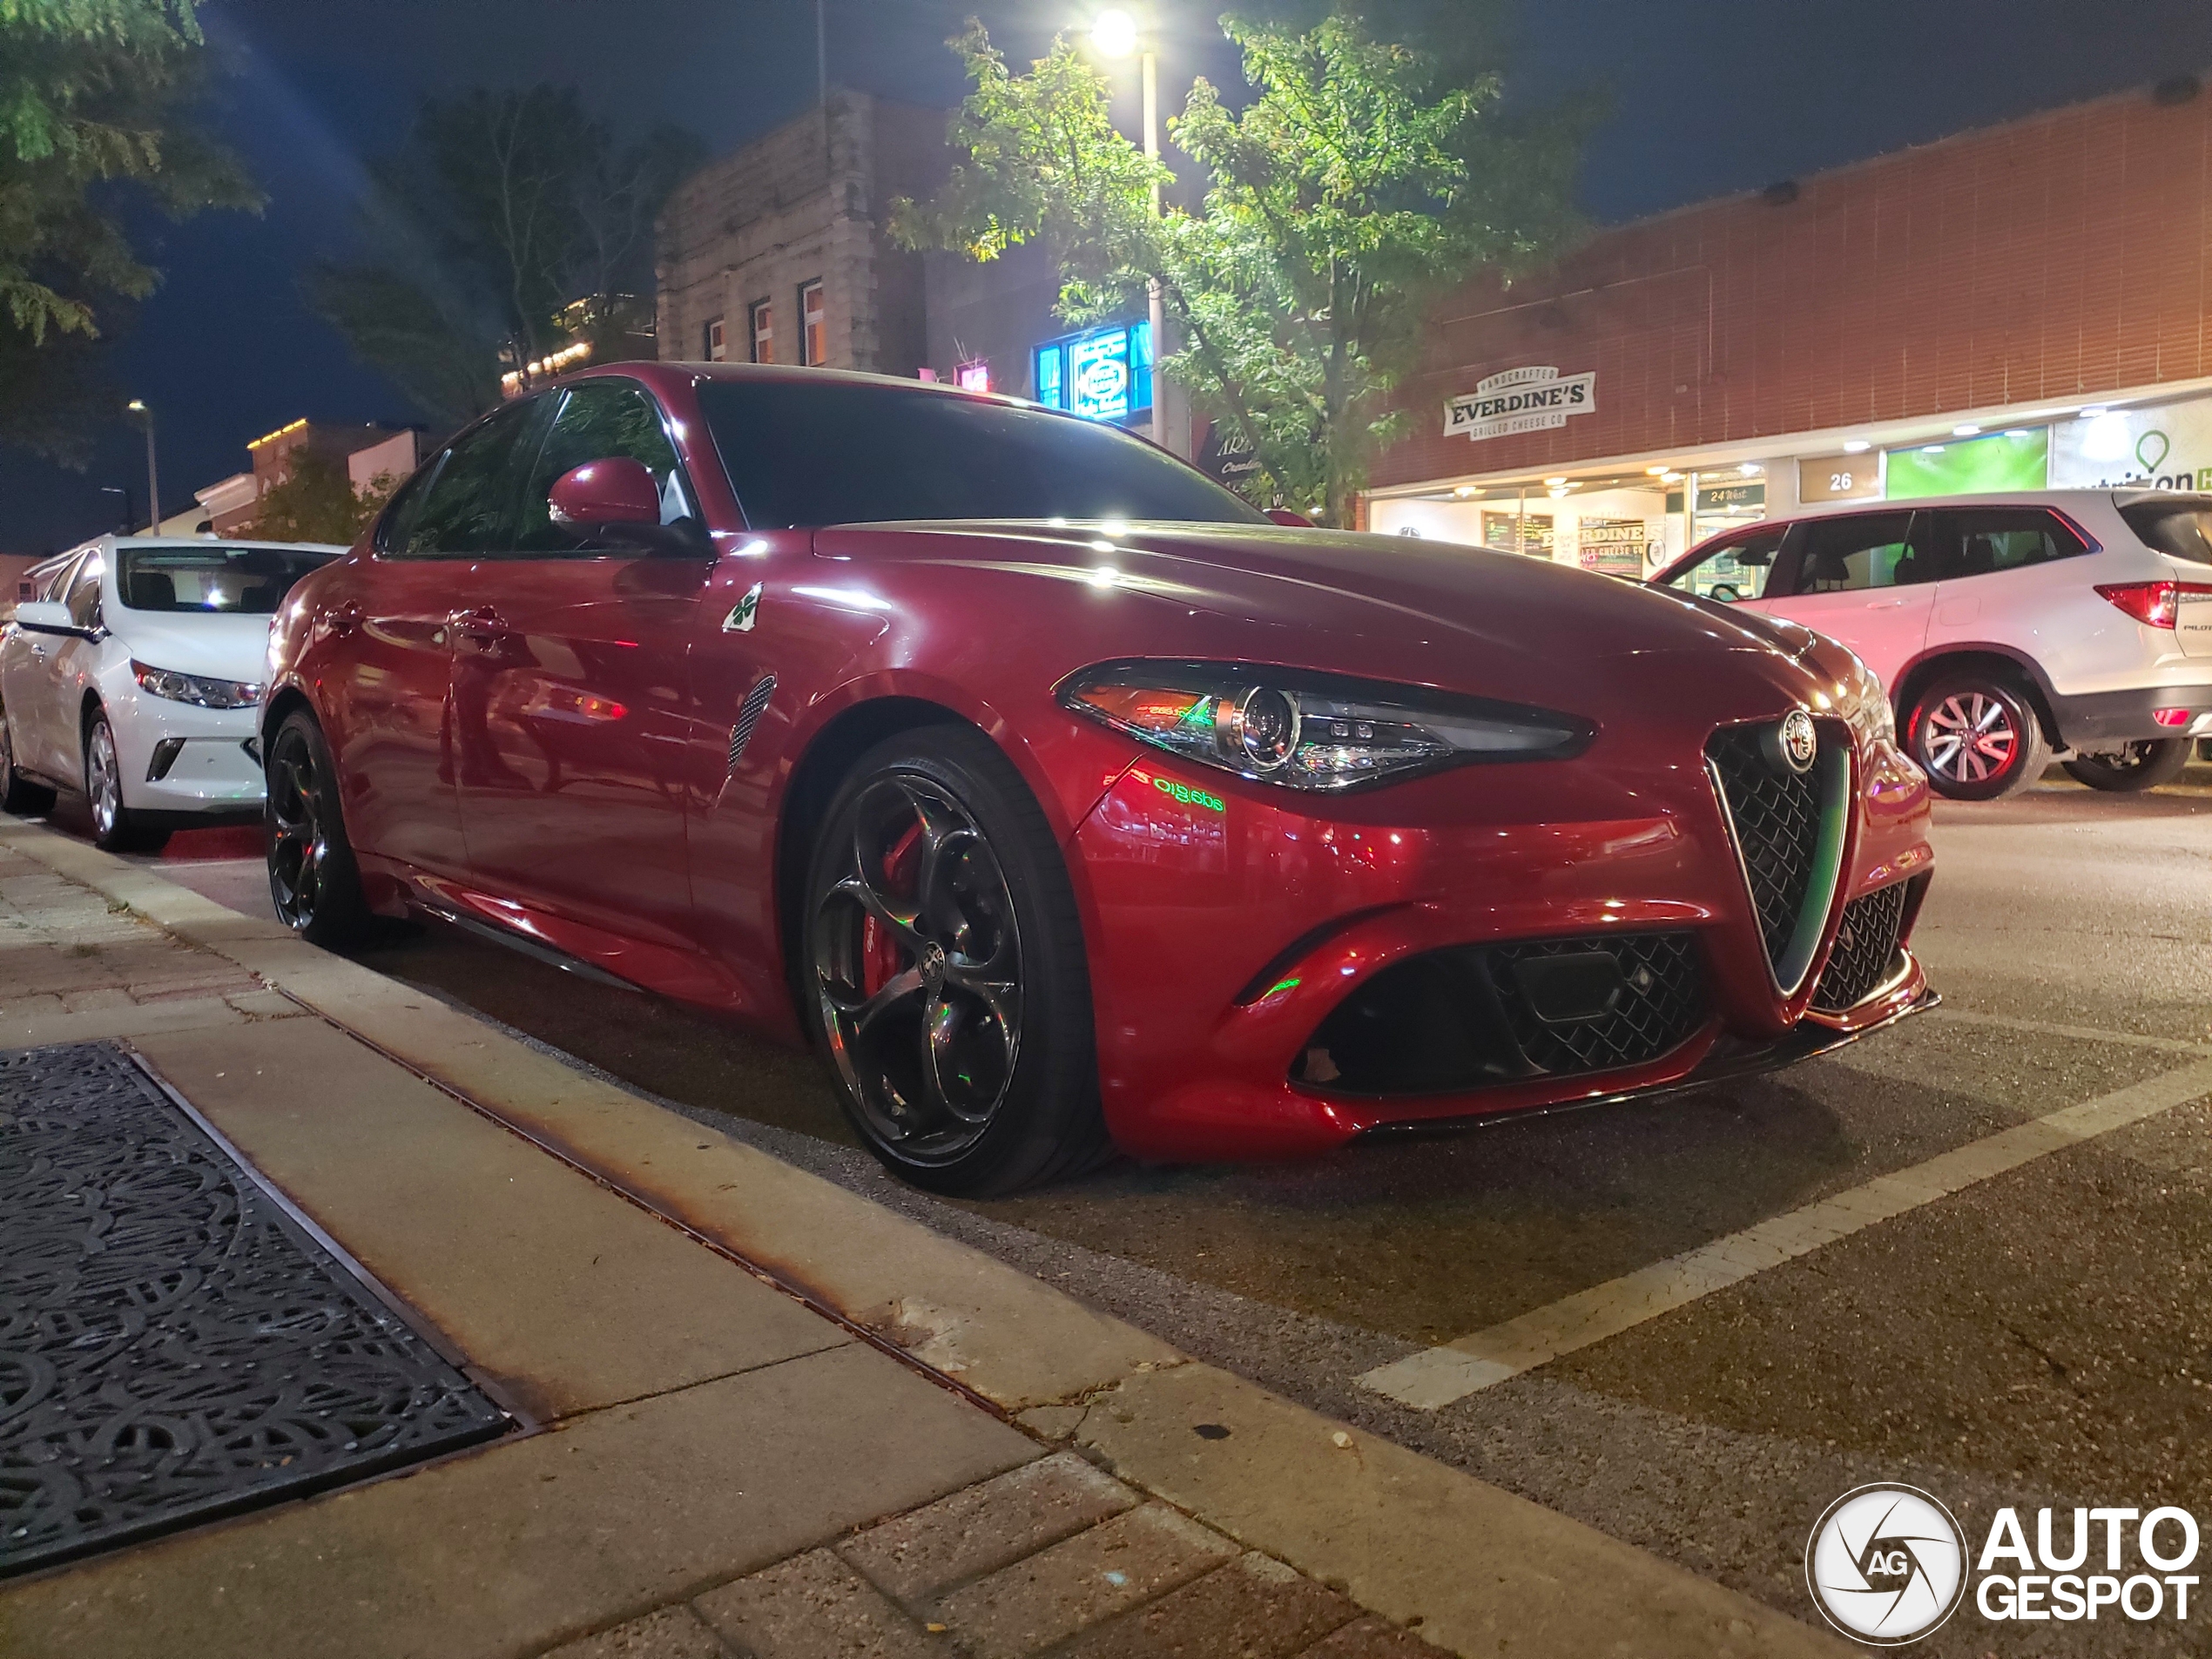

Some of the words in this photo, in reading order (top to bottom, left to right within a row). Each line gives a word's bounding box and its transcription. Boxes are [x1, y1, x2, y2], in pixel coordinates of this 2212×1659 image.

[1480, 369, 1555, 391] HANDCRAFTED
[1452, 384, 1584, 425] EVERDINE'S
[1473, 423, 1508, 437] GRILLED
[1512, 415, 1546, 430] CHEESE
[1830, 472, 1852, 491] 26
[1710, 490, 1724, 502] 24
[1725, 489, 1748, 500] West
